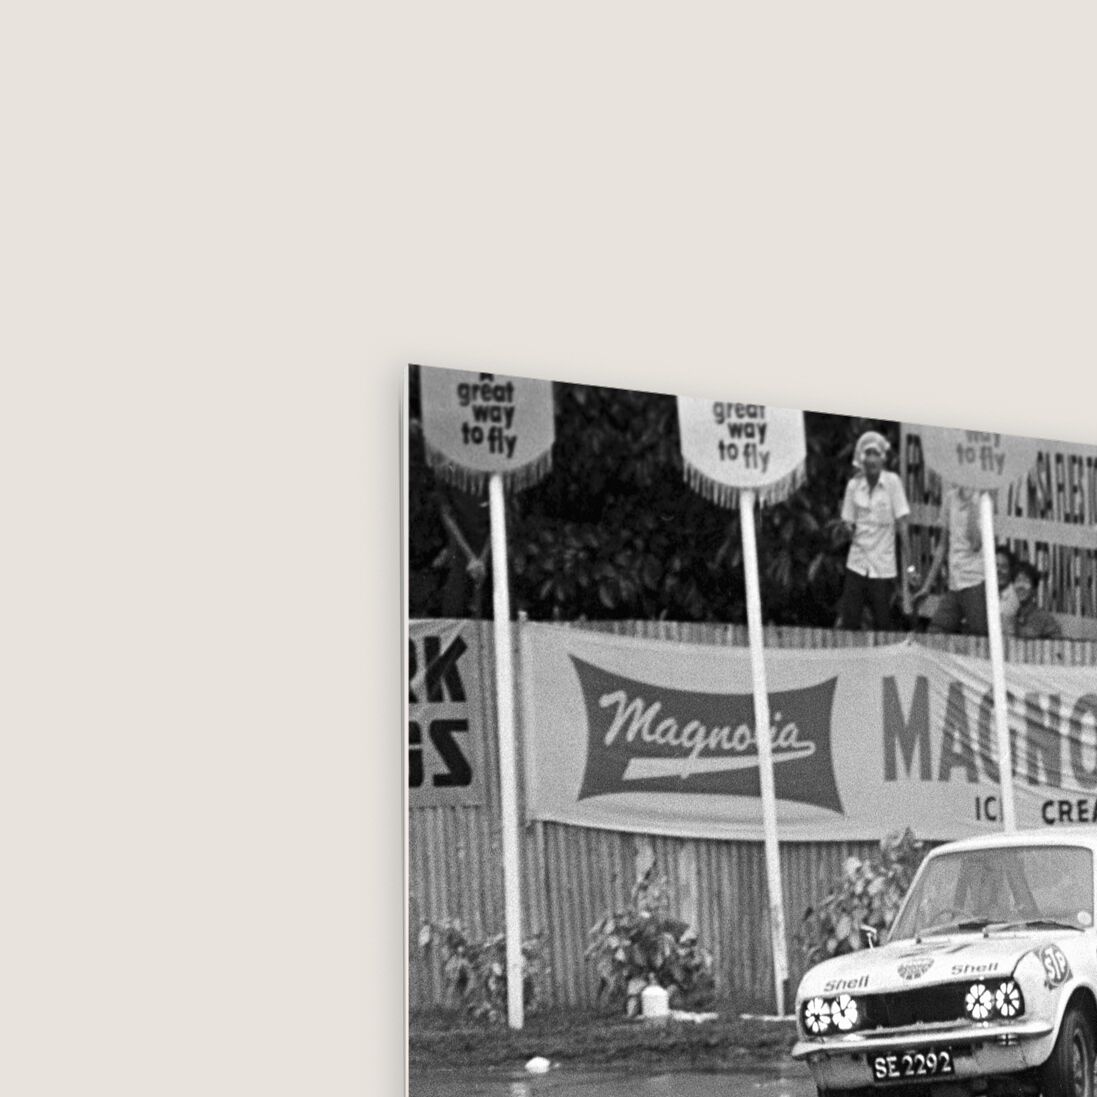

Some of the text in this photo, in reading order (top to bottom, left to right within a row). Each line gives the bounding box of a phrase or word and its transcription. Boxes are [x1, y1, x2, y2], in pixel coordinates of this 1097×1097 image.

[457, 381, 514, 407] great
[472, 405, 515, 429] way
[713, 401, 765, 424] great
[461, 422, 517, 459] to fly
[728, 422, 767, 445] way
[718, 440, 770, 474] to fly
[956, 443, 1006, 476] to fly
[600, 690, 816, 779] Magnoia
[975, 797, 1003, 821] IC
[951, 962, 999, 975] Shell
[1044, 947, 1067, 980] STP
[824, 974, 870, 993] Shell
[874, 1051, 952, 1079] SE 2292
